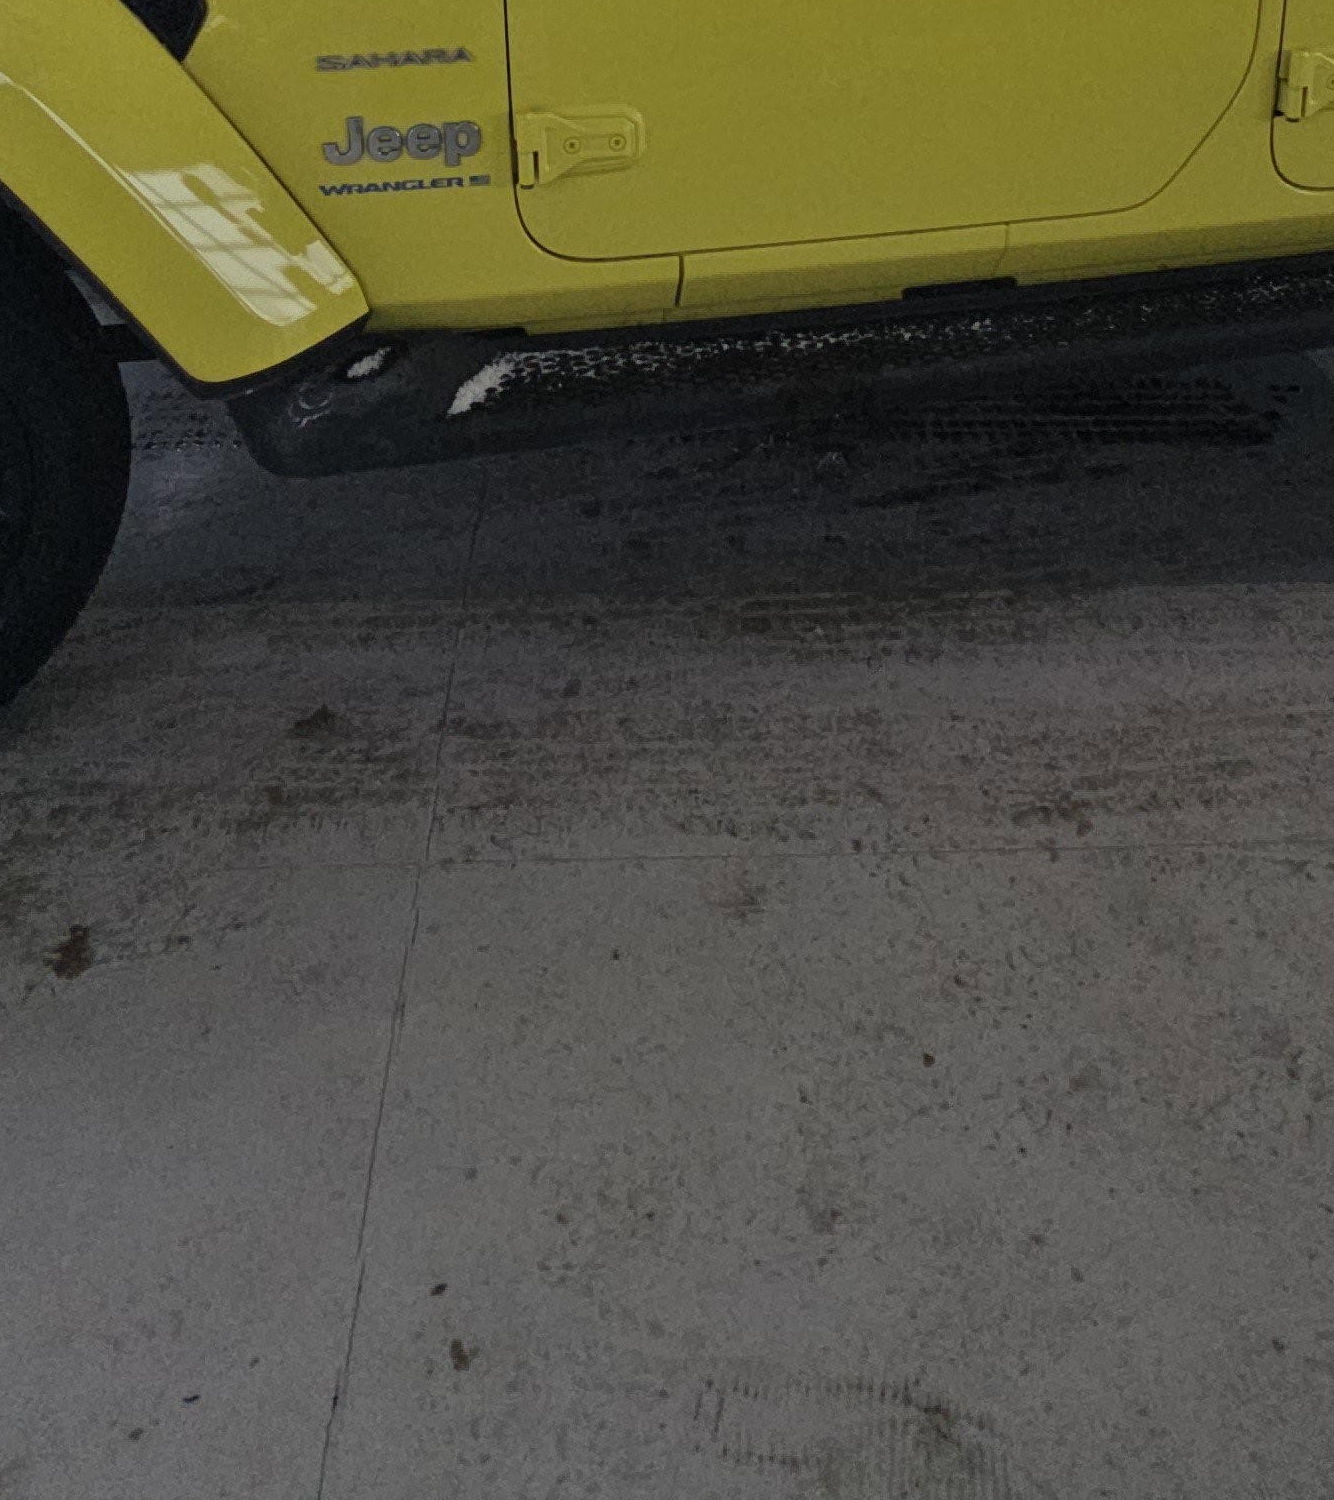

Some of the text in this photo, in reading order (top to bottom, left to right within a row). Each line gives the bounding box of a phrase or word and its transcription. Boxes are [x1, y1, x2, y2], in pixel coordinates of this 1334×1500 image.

[316, 47, 474, 72] SAHARA
[322, 116, 482, 167] Jeep
[318, 176, 464, 197] WRANGLER
